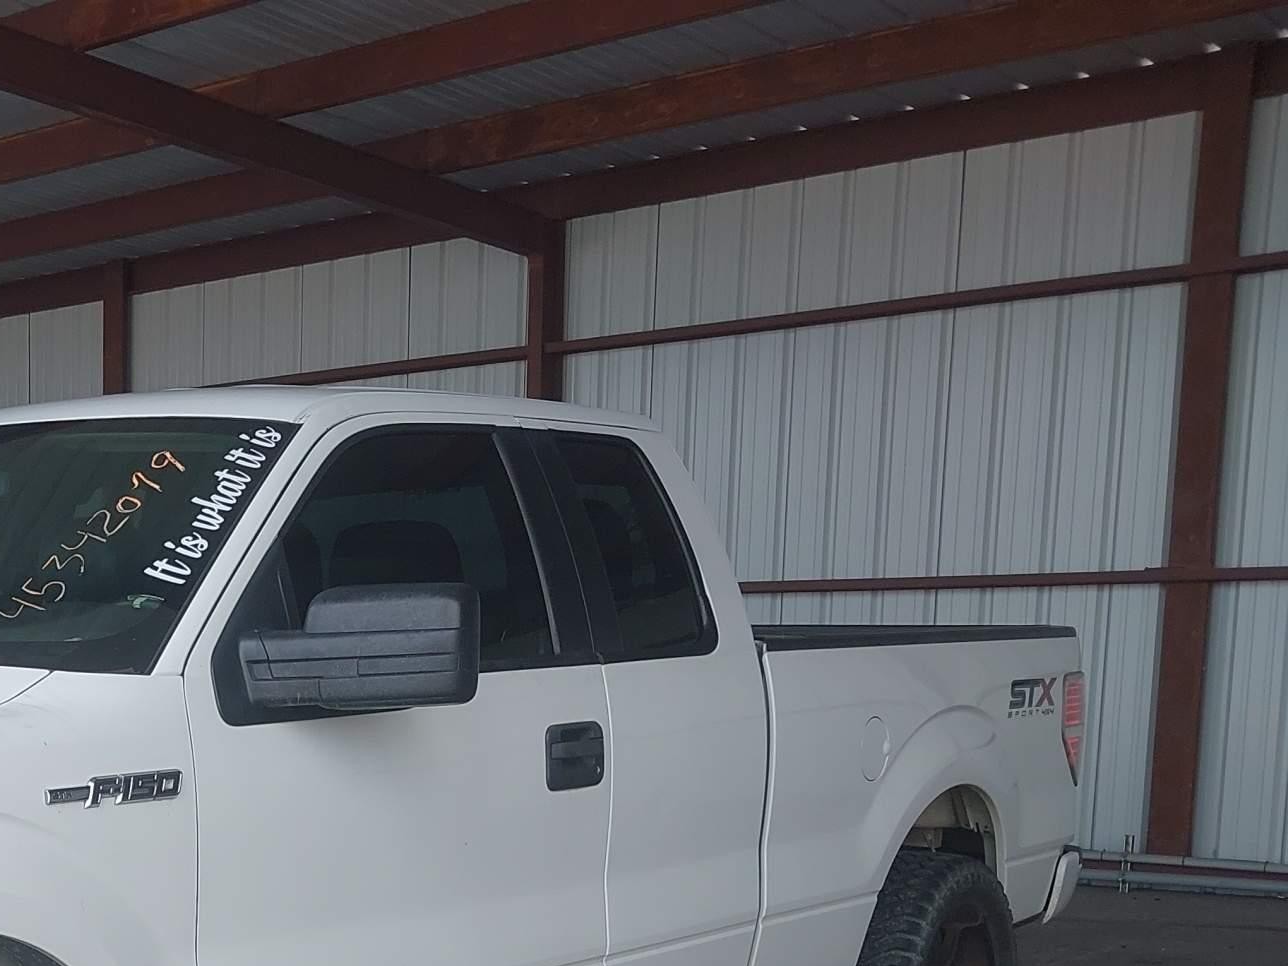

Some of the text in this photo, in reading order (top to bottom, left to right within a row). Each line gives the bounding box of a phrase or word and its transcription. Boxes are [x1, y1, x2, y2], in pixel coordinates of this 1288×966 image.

[143, 425, 282, 585] It is what it is
[1008, 676, 1058, 710] STX
